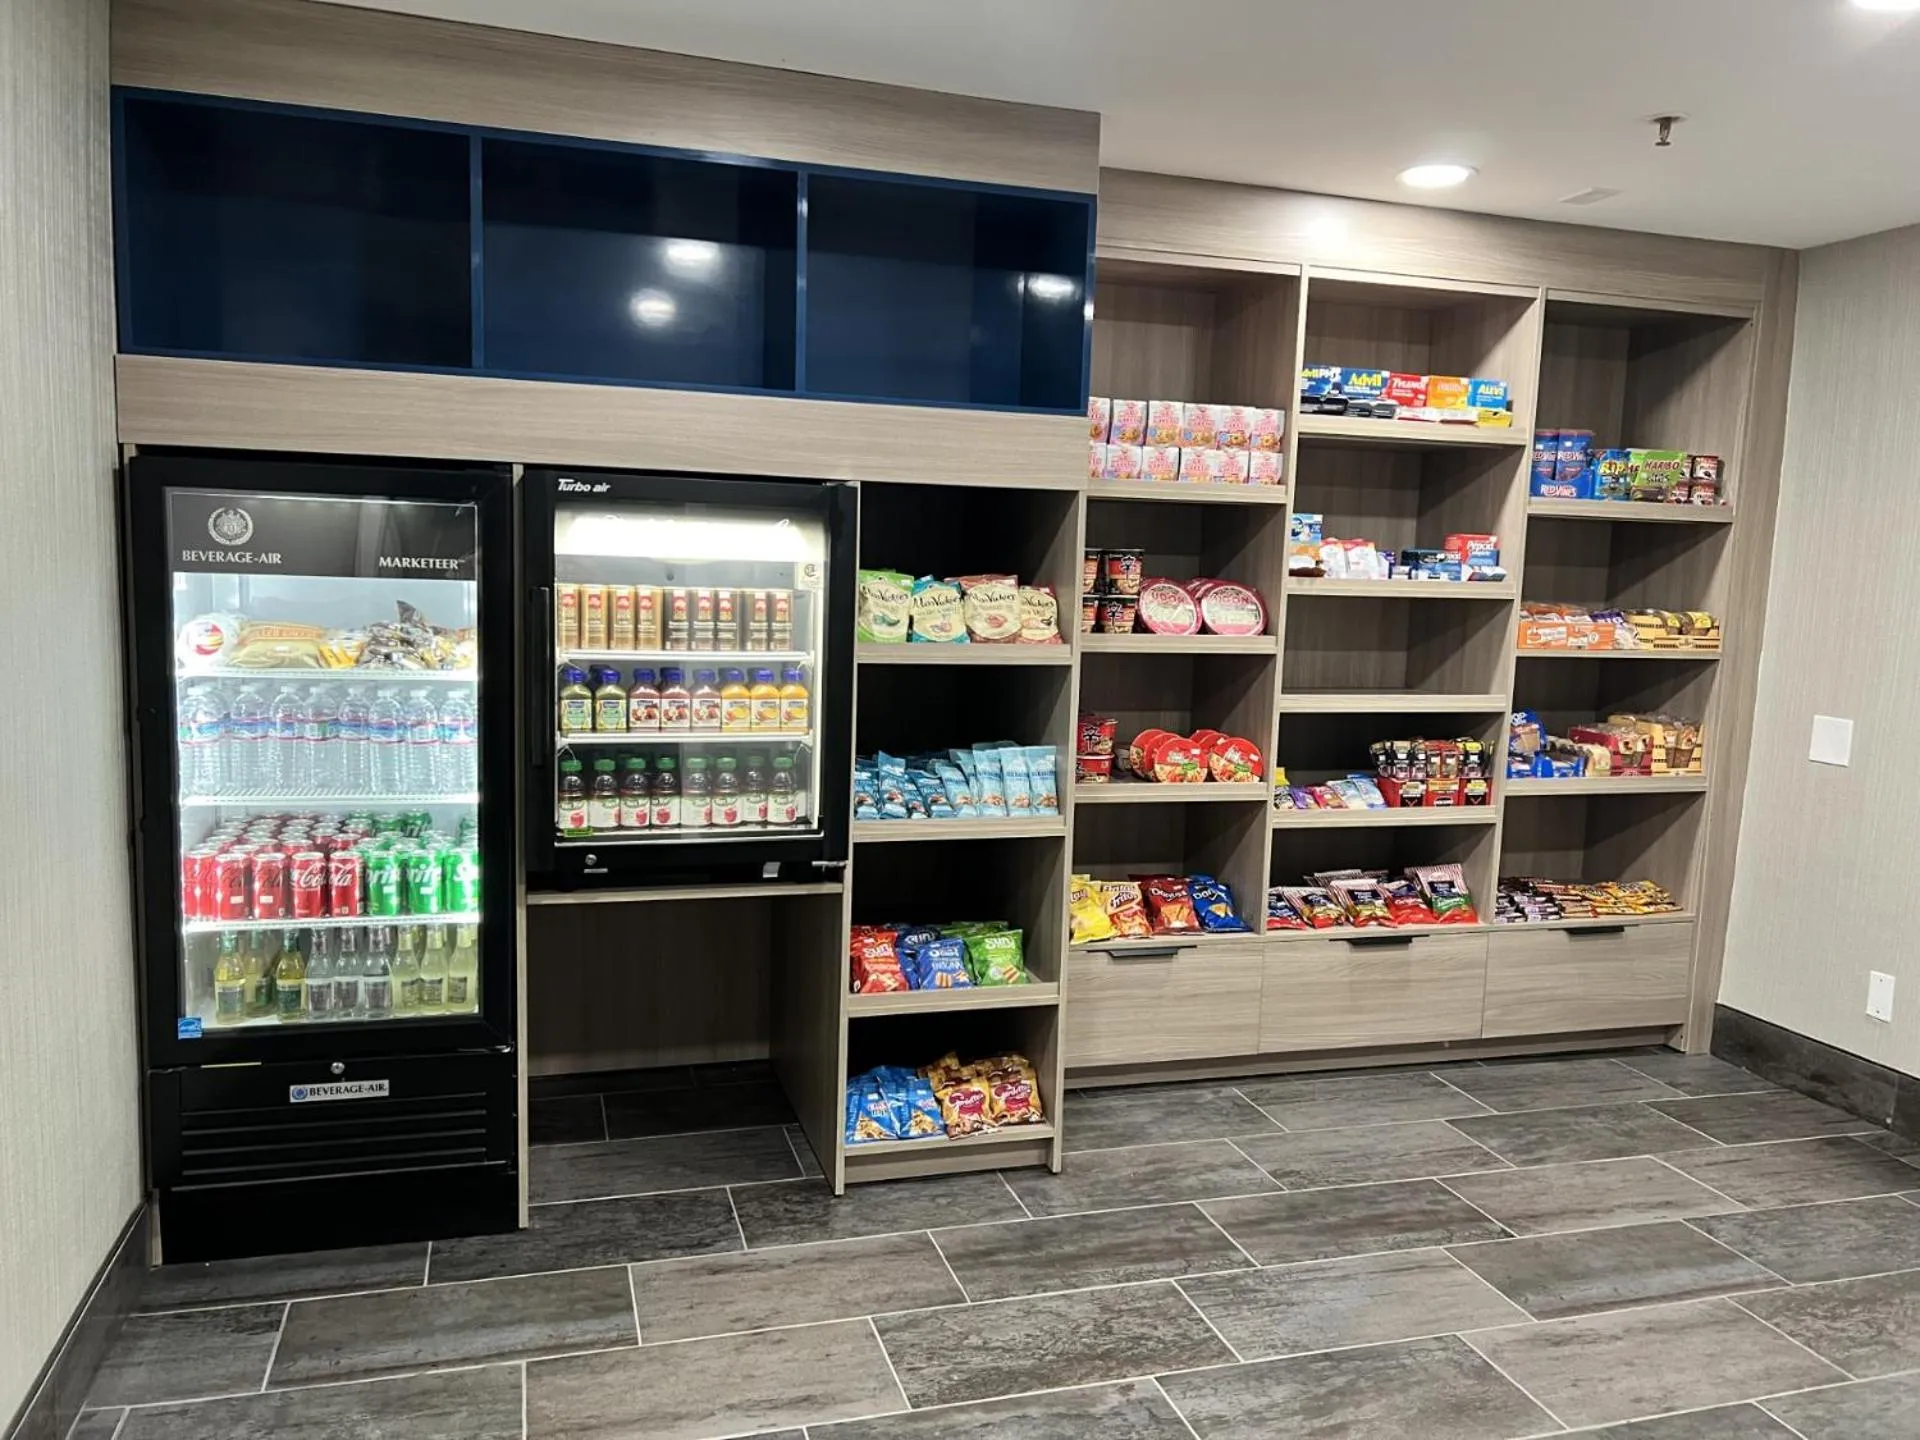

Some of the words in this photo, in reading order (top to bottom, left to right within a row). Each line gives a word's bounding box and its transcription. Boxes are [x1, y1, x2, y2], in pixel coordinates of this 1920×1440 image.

[1348, 373, 1382, 388] Advil
[1645, 460, 1680, 471] HARIBO
[557, 478, 591, 492] Turbo
[592, 481, 611, 493] air
[182, 549, 282, 565] BEVERAGE-AIR
[379, 556, 459, 571] MARKETEER
[309, 1082, 387, 1097] BEVERAGE-AIR
